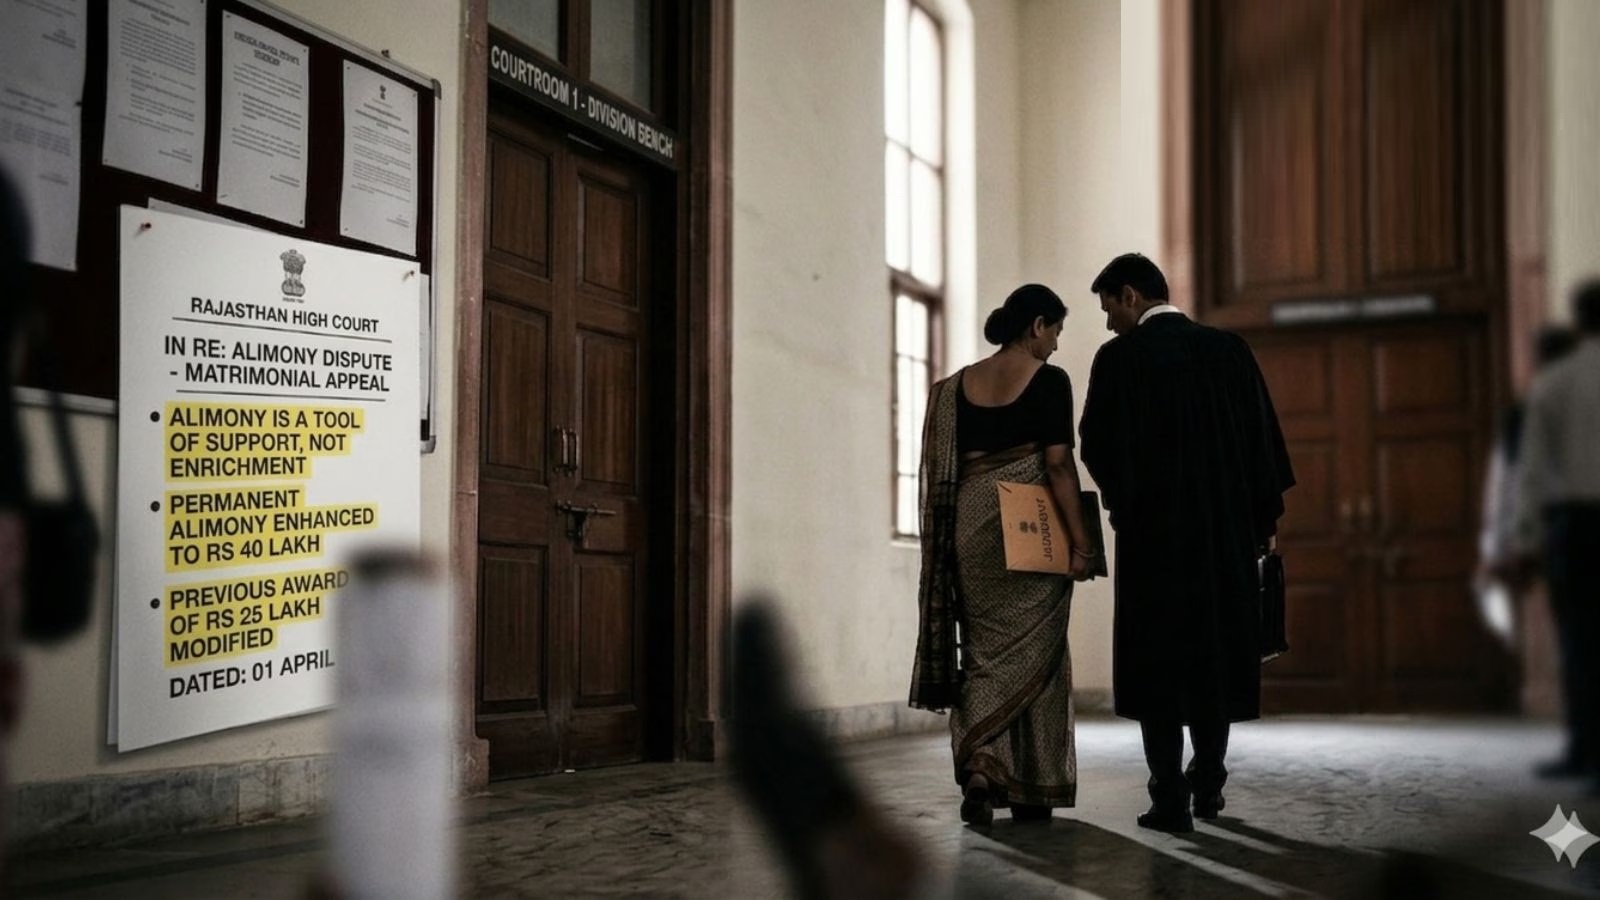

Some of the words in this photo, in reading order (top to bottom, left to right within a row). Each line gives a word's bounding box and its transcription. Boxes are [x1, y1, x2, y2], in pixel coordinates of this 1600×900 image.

[491, 45, 569, 106] COURTROOM
[573, 88, 578, 110] 1
[588, 96, 636, 140] DIVISION
[191, 297, 288, 323] RAJASTHAN
[293, 311, 328, 328] HIGH
[332, 315, 379, 333] COURT
[164, 336, 186, 356] IN
[193, 338, 226, 359] RE:
[232, 342, 318, 365] ALIMONY
[323, 350, 392, 371] DISPUTE
[185, 363, 320, 388] MATRIMONIAL
[326, 373, 390, 391] APPEAL
[169, 408, 266, 427] ALIMONY
[273, 409, 289, 428] IS
[295, 410, 309, 428] A
[313, 411, 360, 429] TOOL
[170, 433, 199, 452] OF
[206, 434, 304, 454] SUPPORT,
[309, 434, 347, 451] NOT
[170, 456, 307, 477] ENRICHMENT
[170, 490, 300, 514] PERMANENT
[169, 515, 267, 540] ALIMONY
[274, 508, 374, 532] ENHANCED
[169, 545, 199, 565] TO
[206, 542, 234, 562] RS
[240, 539, 263, 559] 40
[269, 535, 320, 557] LAKH
[170, 580, 276, 610] PREVIOUS
[282, 571, 349, 596] AWARD
[170, 615, 199, 635] OF
[206, 611, 234, 631] RS
[240, 607, 263, 625] 25
[269, 597, 320, 621] LAKH
[170, 628, 273, 662] MODIFIED
[170, 667, 247, 698] DATED:
[252, 661, 273, 681] 01
[280, 650, 335, 676] APRIL
